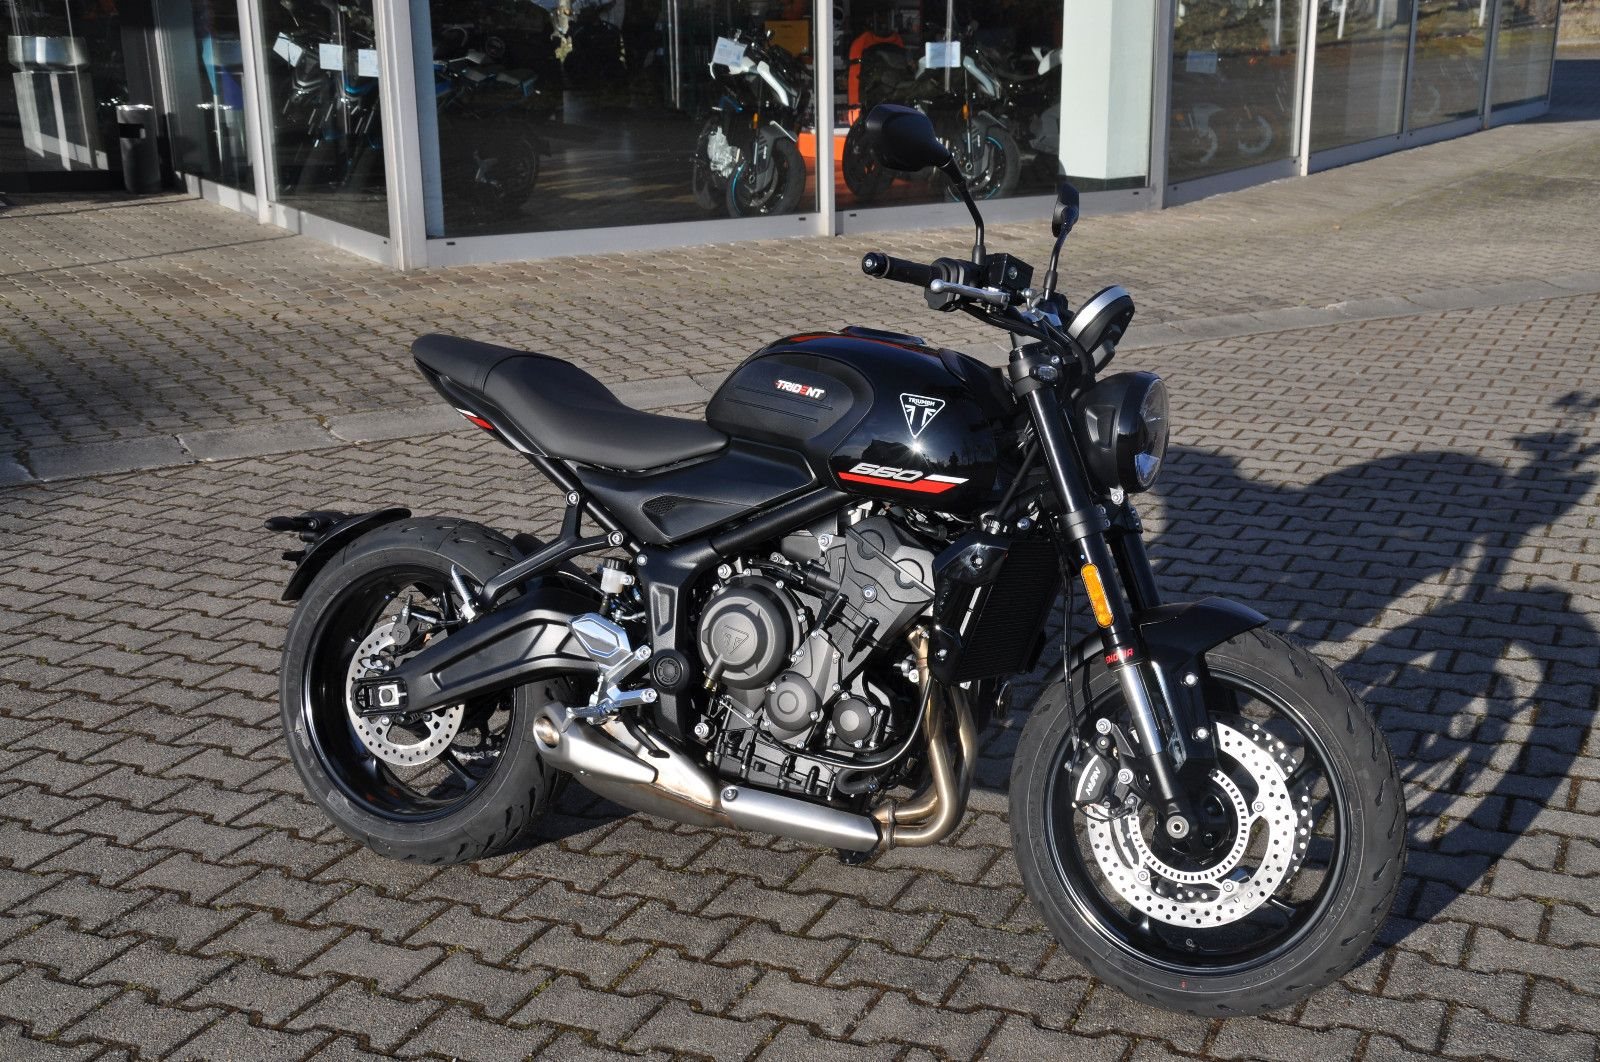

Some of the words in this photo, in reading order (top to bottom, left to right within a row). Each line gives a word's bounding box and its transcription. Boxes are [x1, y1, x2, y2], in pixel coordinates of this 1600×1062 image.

[775, 379, 825, 399] TRIDENT
[908, 397, 936, 407] TRIUMPH
[848, 462, 924, 482] 660
